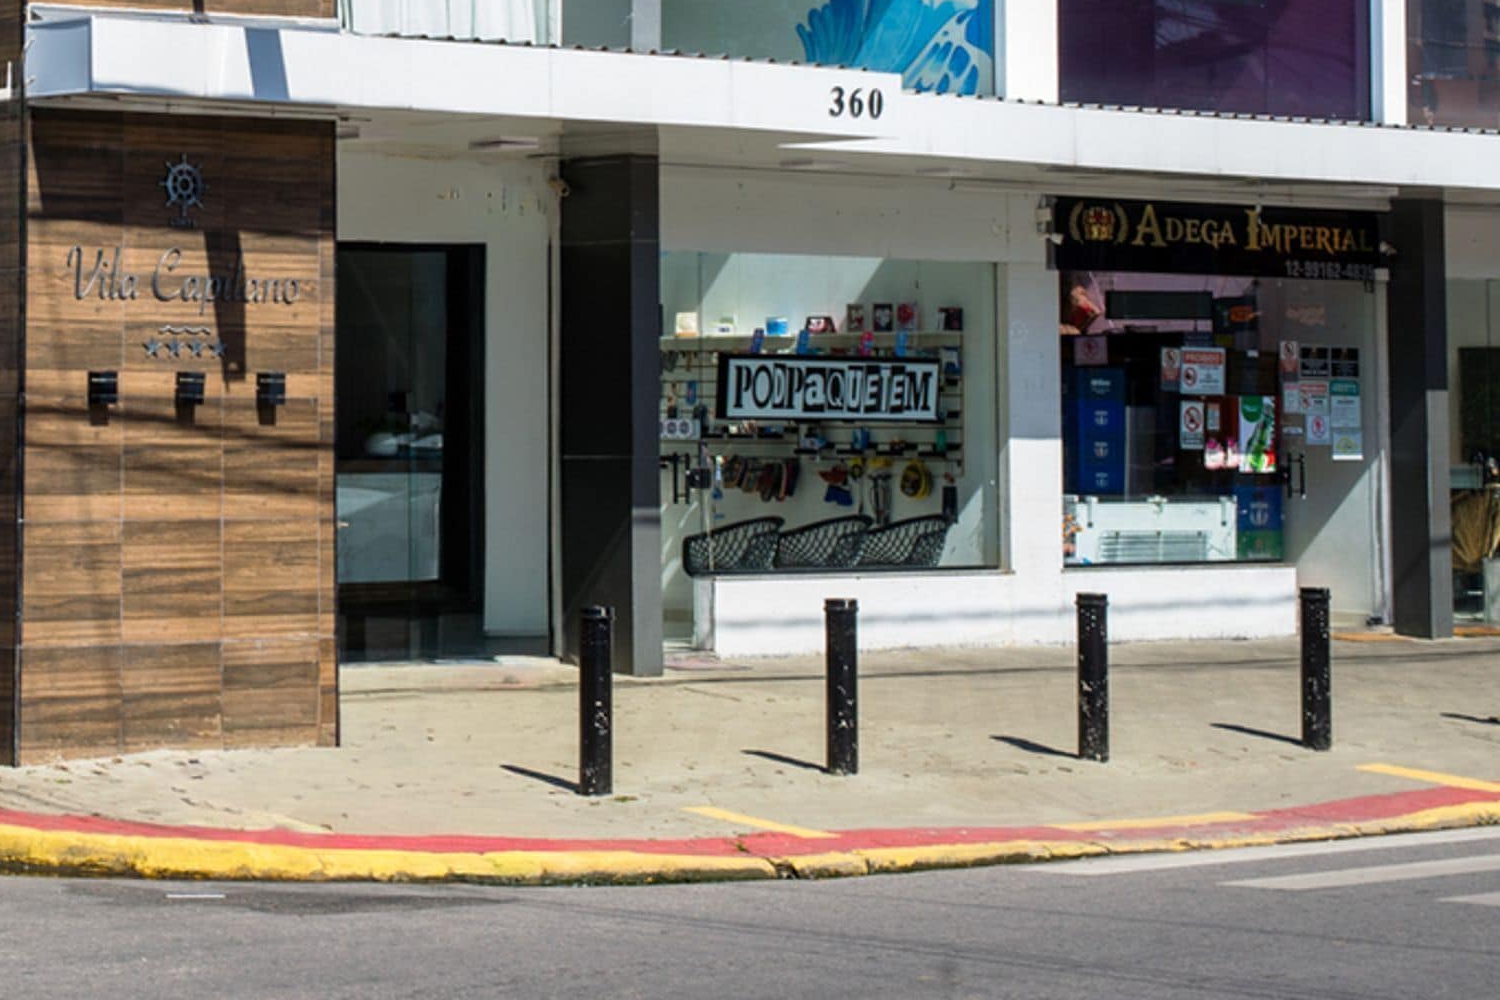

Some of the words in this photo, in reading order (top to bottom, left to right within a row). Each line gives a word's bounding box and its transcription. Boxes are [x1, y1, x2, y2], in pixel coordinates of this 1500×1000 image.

[828, 85, 884, 120] 360
[1131, 203, 1236, 249] ADEGA
[1244, 207, 1375, 254] IMPERIAL
[67, 244, 139, 301] Vila
[152, 246, 300, 316] Capilano
